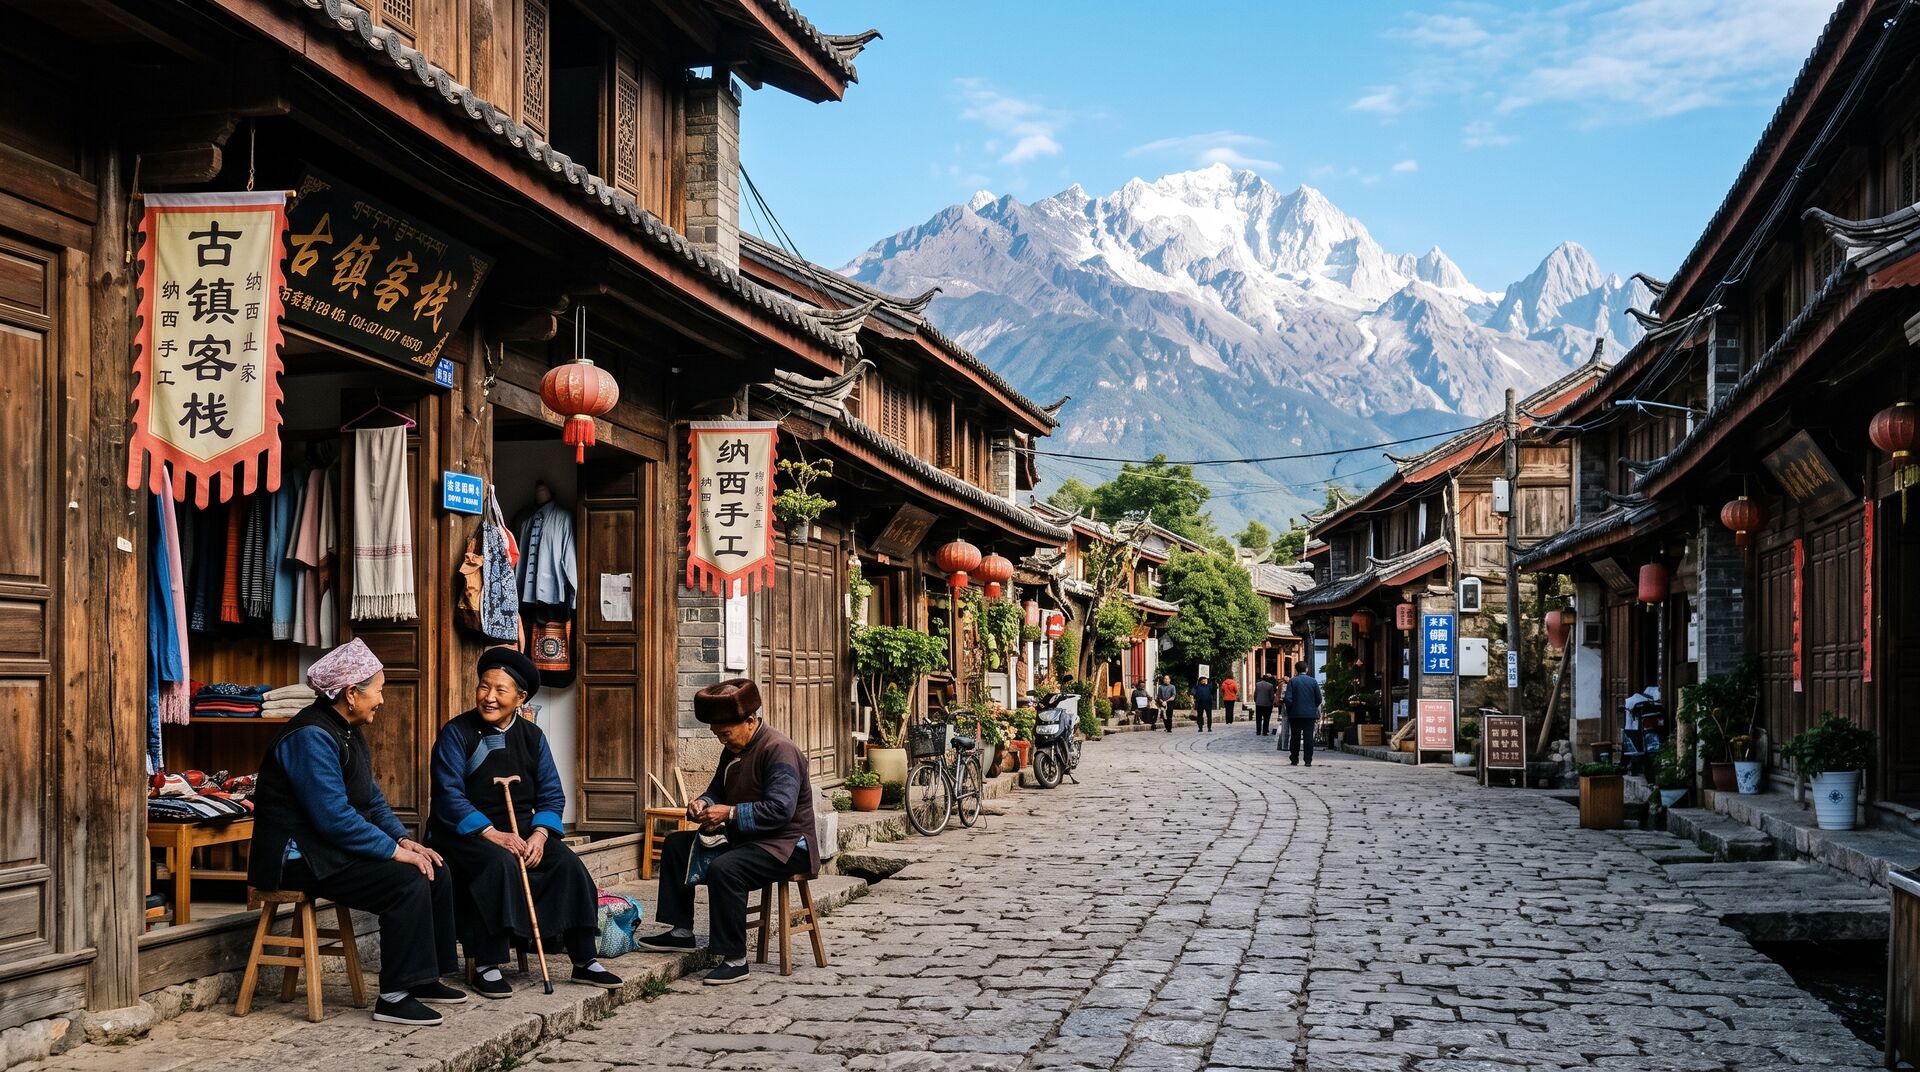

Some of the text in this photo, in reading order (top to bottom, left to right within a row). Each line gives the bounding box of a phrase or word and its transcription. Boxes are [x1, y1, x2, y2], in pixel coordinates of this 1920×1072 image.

[157, 281, 180, 386] 纳西手工
[178, 220, 243, 440] 古镇客栈
[714, 438, 750, 558] 纳西手工
